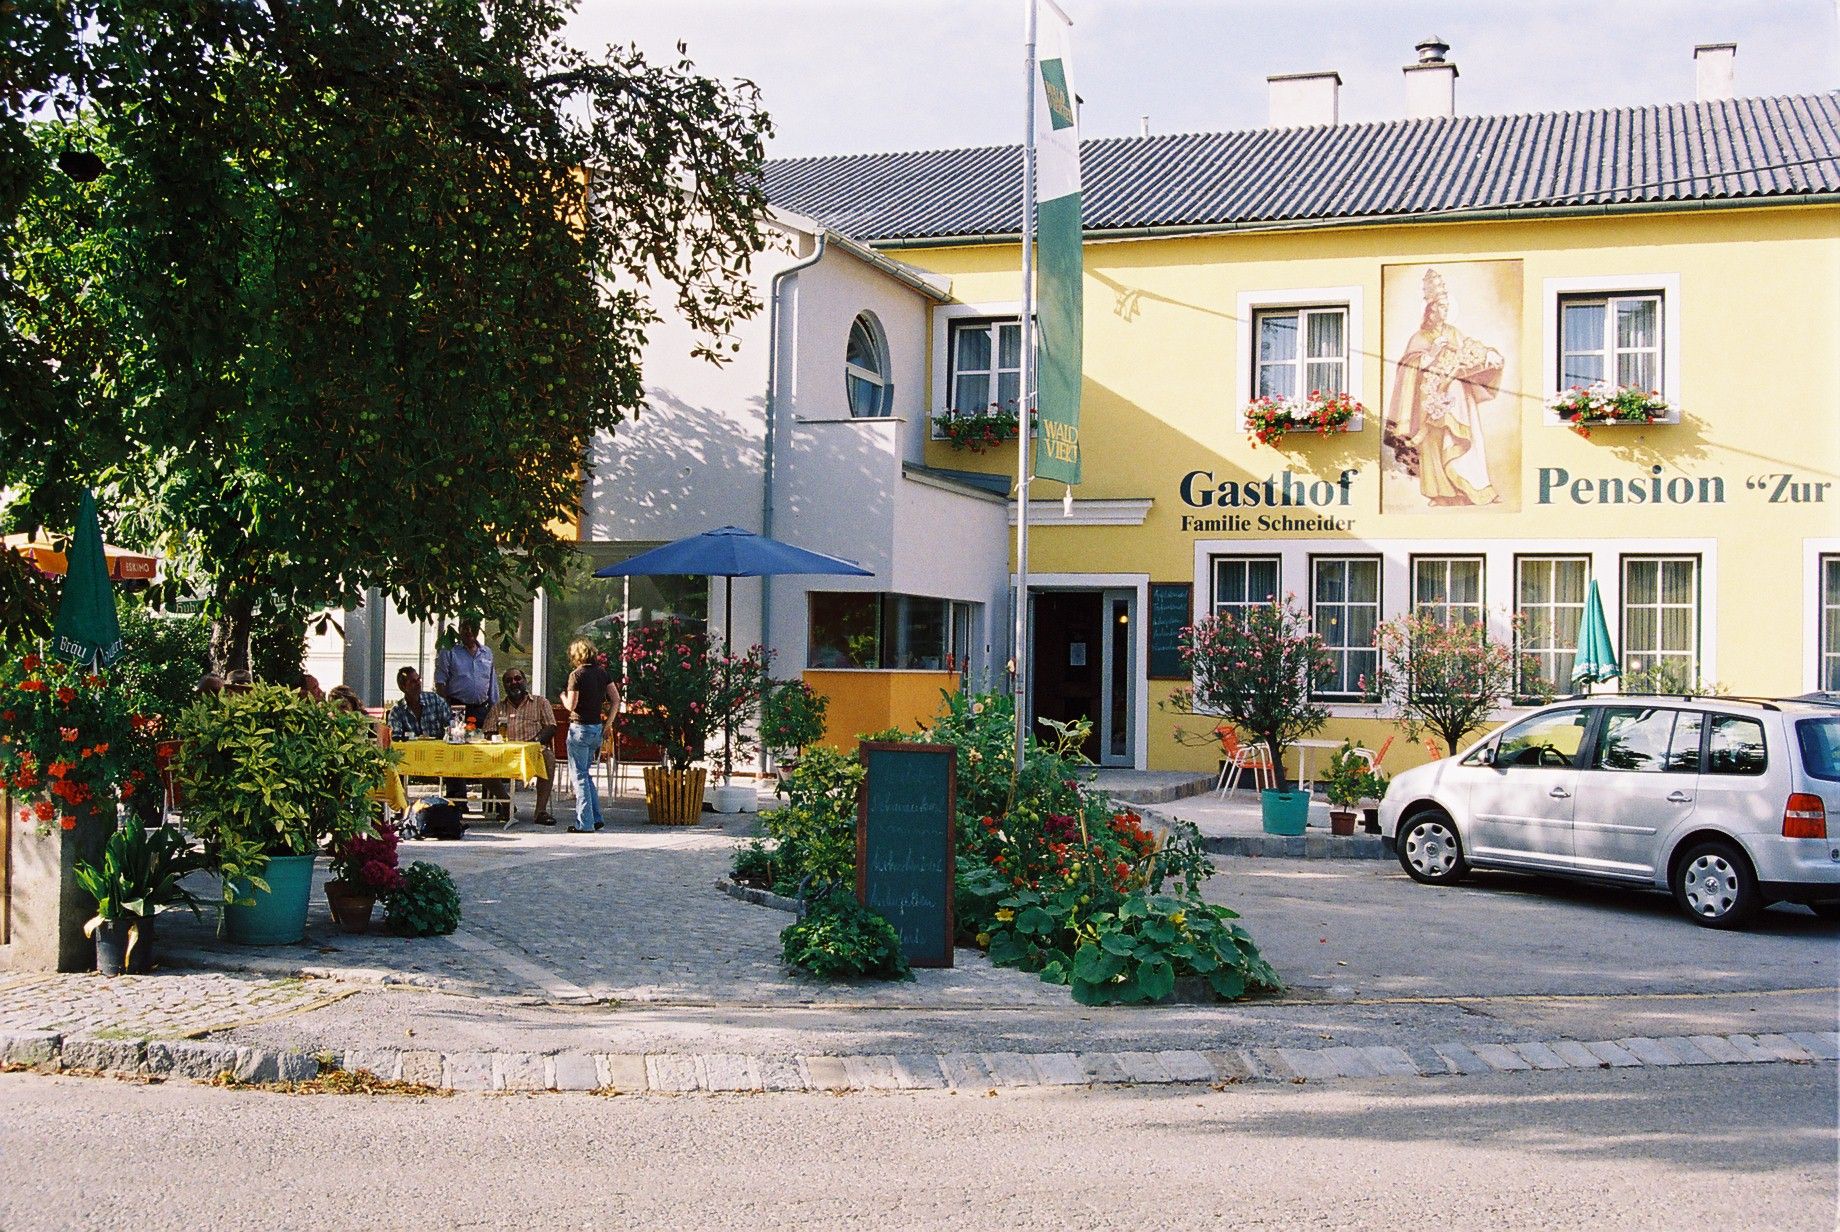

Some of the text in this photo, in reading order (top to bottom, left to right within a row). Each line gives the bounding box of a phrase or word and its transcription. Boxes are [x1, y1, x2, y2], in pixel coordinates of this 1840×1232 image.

[1043, 419, 1078, 444] WALD
[1179, 469, 1358, 508] Gasthof
[1535, 465, 1726, 505] Pension
[1181, 514, 1356, 532] Familie Schneider
[125, 562, 150, 573] ESKIMO
[60, 636, 87, 659] Bräu
